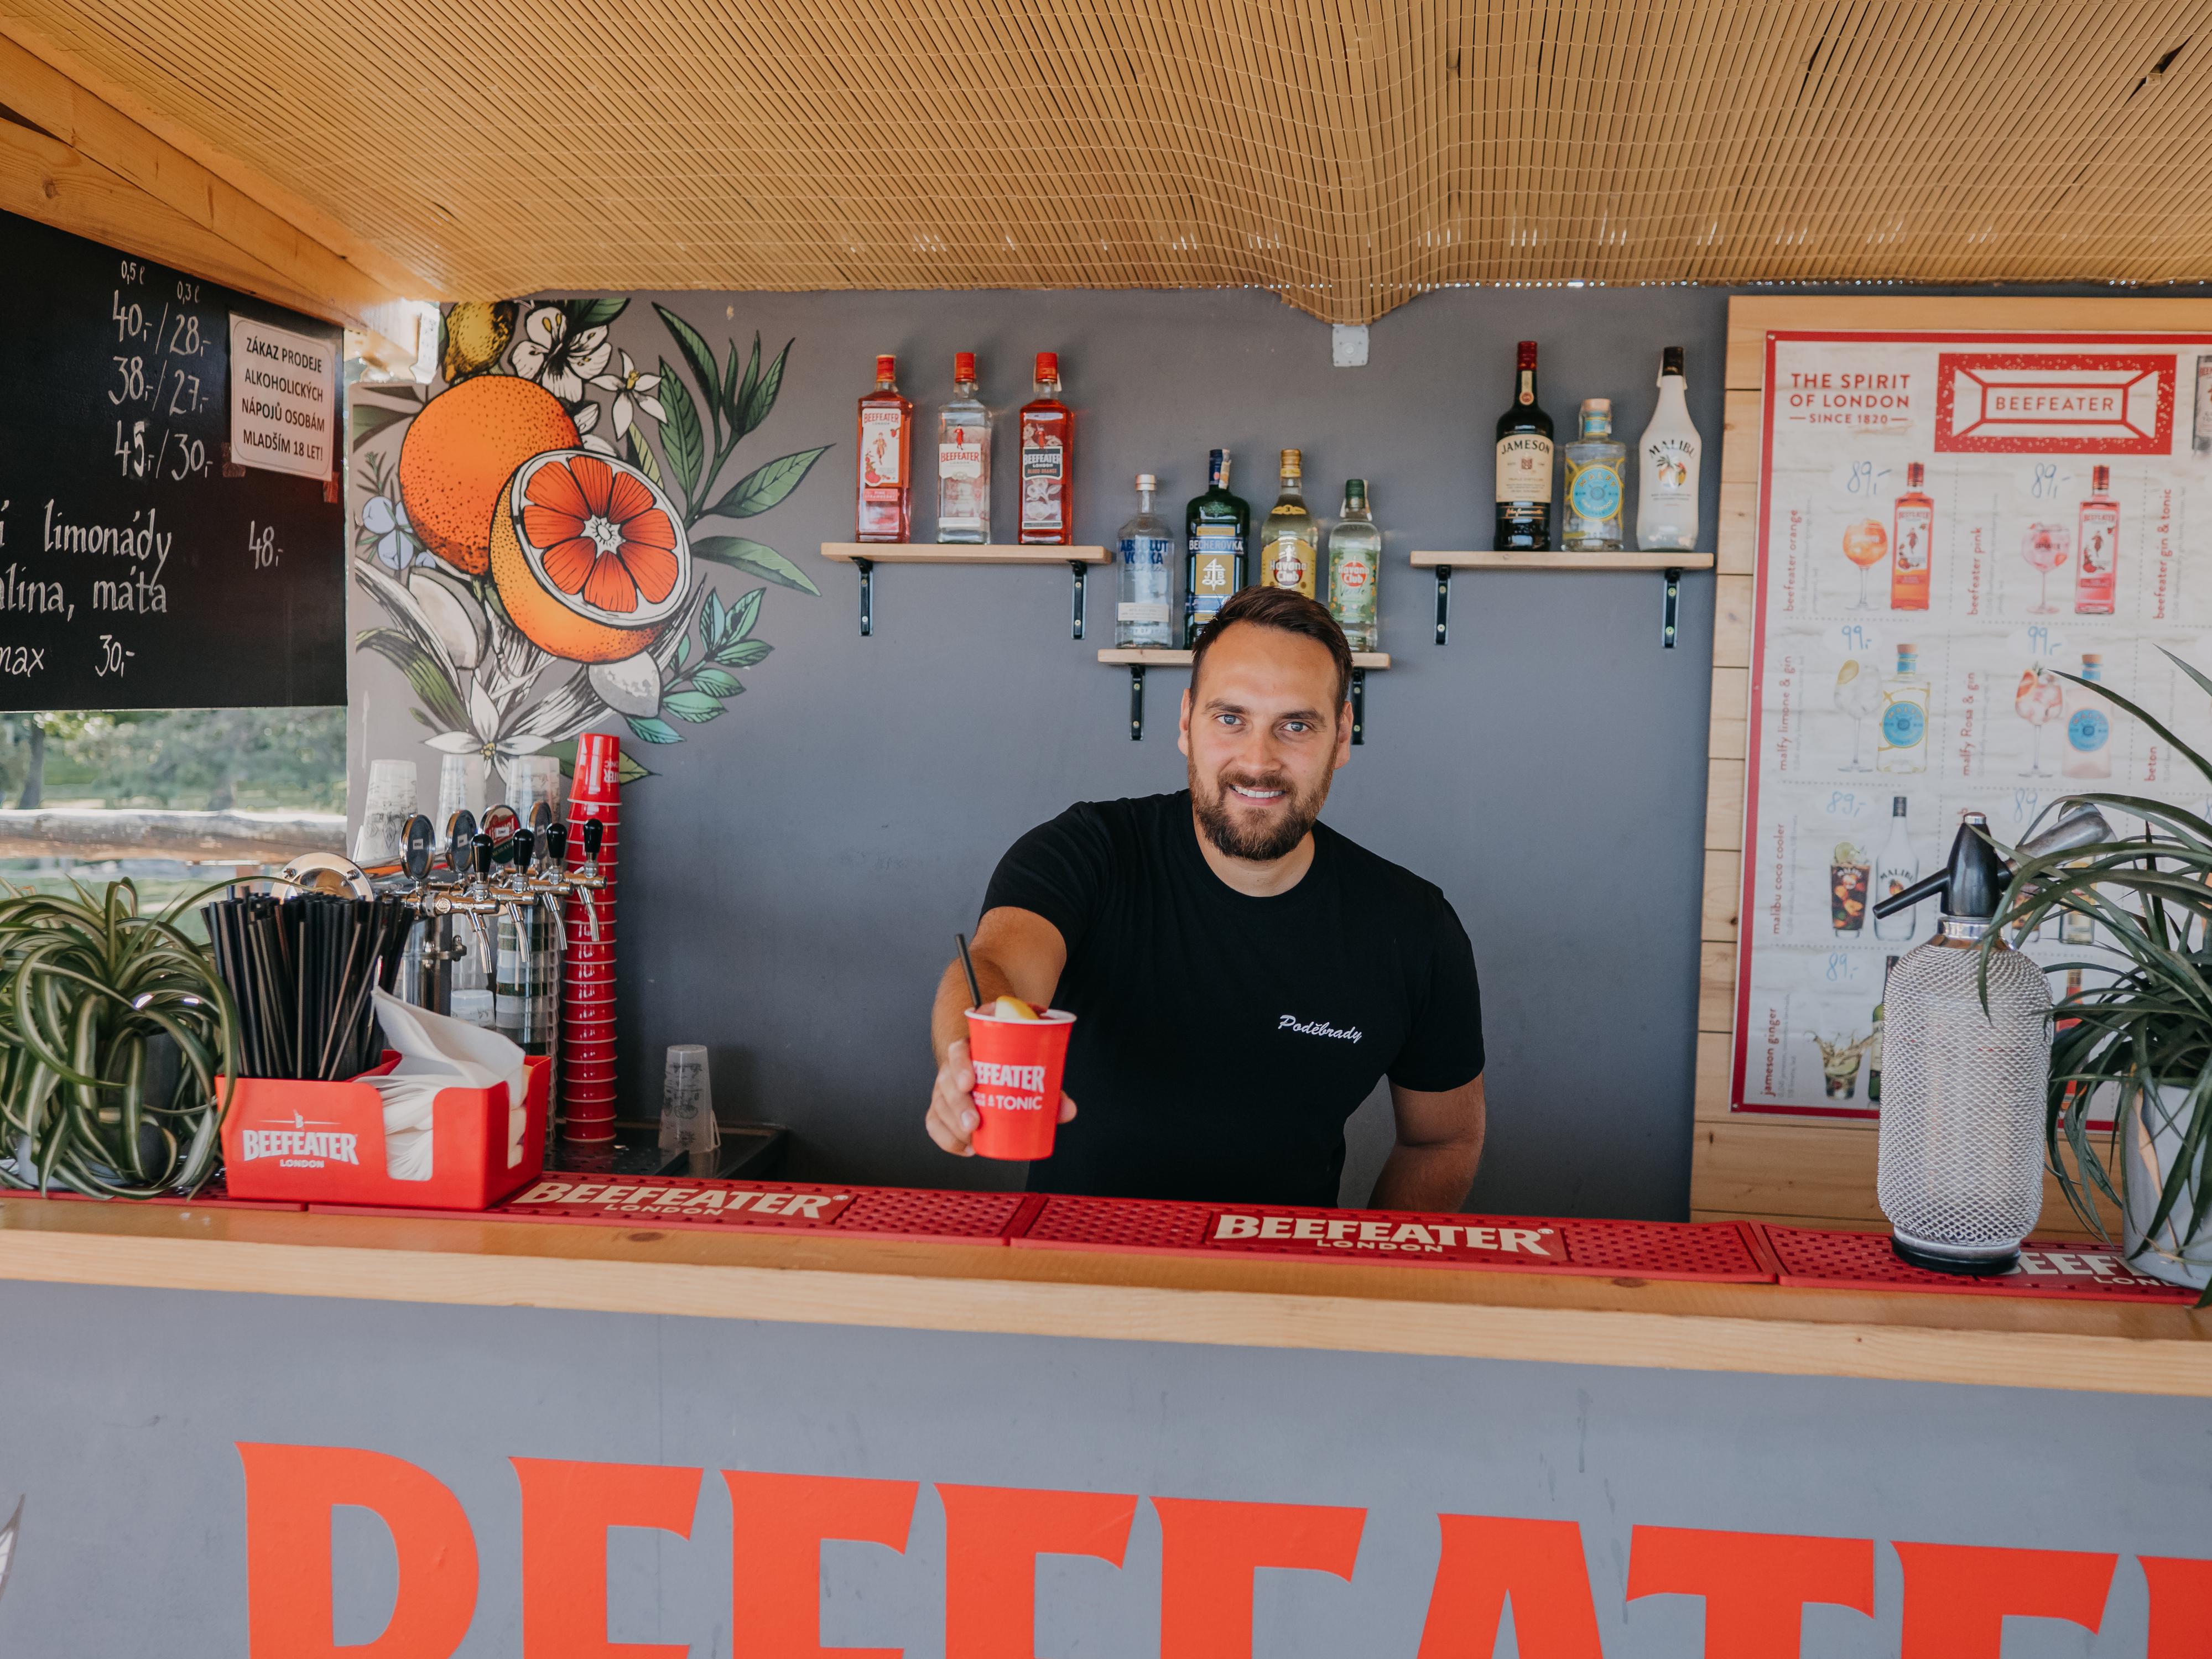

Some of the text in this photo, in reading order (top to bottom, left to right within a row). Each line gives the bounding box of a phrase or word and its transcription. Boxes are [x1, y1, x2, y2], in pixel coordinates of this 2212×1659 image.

[122, 260, 137, 285] 0,5
[177, 280, 191, 304] 0,3
[246, 335, 322, 374] ZÁKAZ PRODEJE
[244, 368, 324, 403] ALKOHOLICKÝCH
[1791, 373, 1911, 390] THE SPIRIT
[242, 396, 325, 432] NÁPOJŮ OSOBÁM
[1790, 394, 1909, 410] OF LONDON
[1995, 395, 2115, 412] BEEFEATER
[863, 413, 899, 425] BEEFEATER
[1809, 413, 1889, 425] SINCE 1820
[243, 428, 324, 462] MLADŠÍM 18 LET!
[940, 452, 980, 462] BEEFEATER
[1501, 439, 1550, 455] JAMESON
[1649, 439, 1696, 459] MALIBU
[1023, 453, 1061, 465] BEEFEATER
[44, 498, 172, 596] limonády
[1120, 539, 1168, 552] ABLUT
[1189, 539, 1243, 551] BECHEROVKA
[2152, 488, 2173, 620] beefeater gin & tonic
[1123, 551, 1163, 565] VKA
[1269, 560, 1307, 571] Havana
[1338, 564, 1370, 574] Havana
[1783, 509, 1803, 612] beefeater orange
[1344, 573, 1363, 583] Club
[1966, 526, 1986, 615] beefeater pink
[92, 565, 168, 614] máta
[1776, 655, 1796, 771] malfy limone & gin
[1959, 672, 1980, 776] malfy Rosa & gin
[2143, 745, 2158, 782] beton
[1769, 823, 1785, 935] malibu coco cooler
[1277, 1014, 1362, 1044] Poděbrady
[1761, 1008, 1781, 1097] jameson ginger
[996, 1094, 1043, 1111] TONIC
[242, 1129, 360, 1166] BEEFEATER
[279, 1159, 325, 1168] LONDON
[512, 1181, 832, 1219] BEEFEATER
[603, 1203, 725, 1217] LONDON
[1214, 1214, 1551, 1256] BEEFEATER
[1316, 1239, 1443, 1253] LONDON
